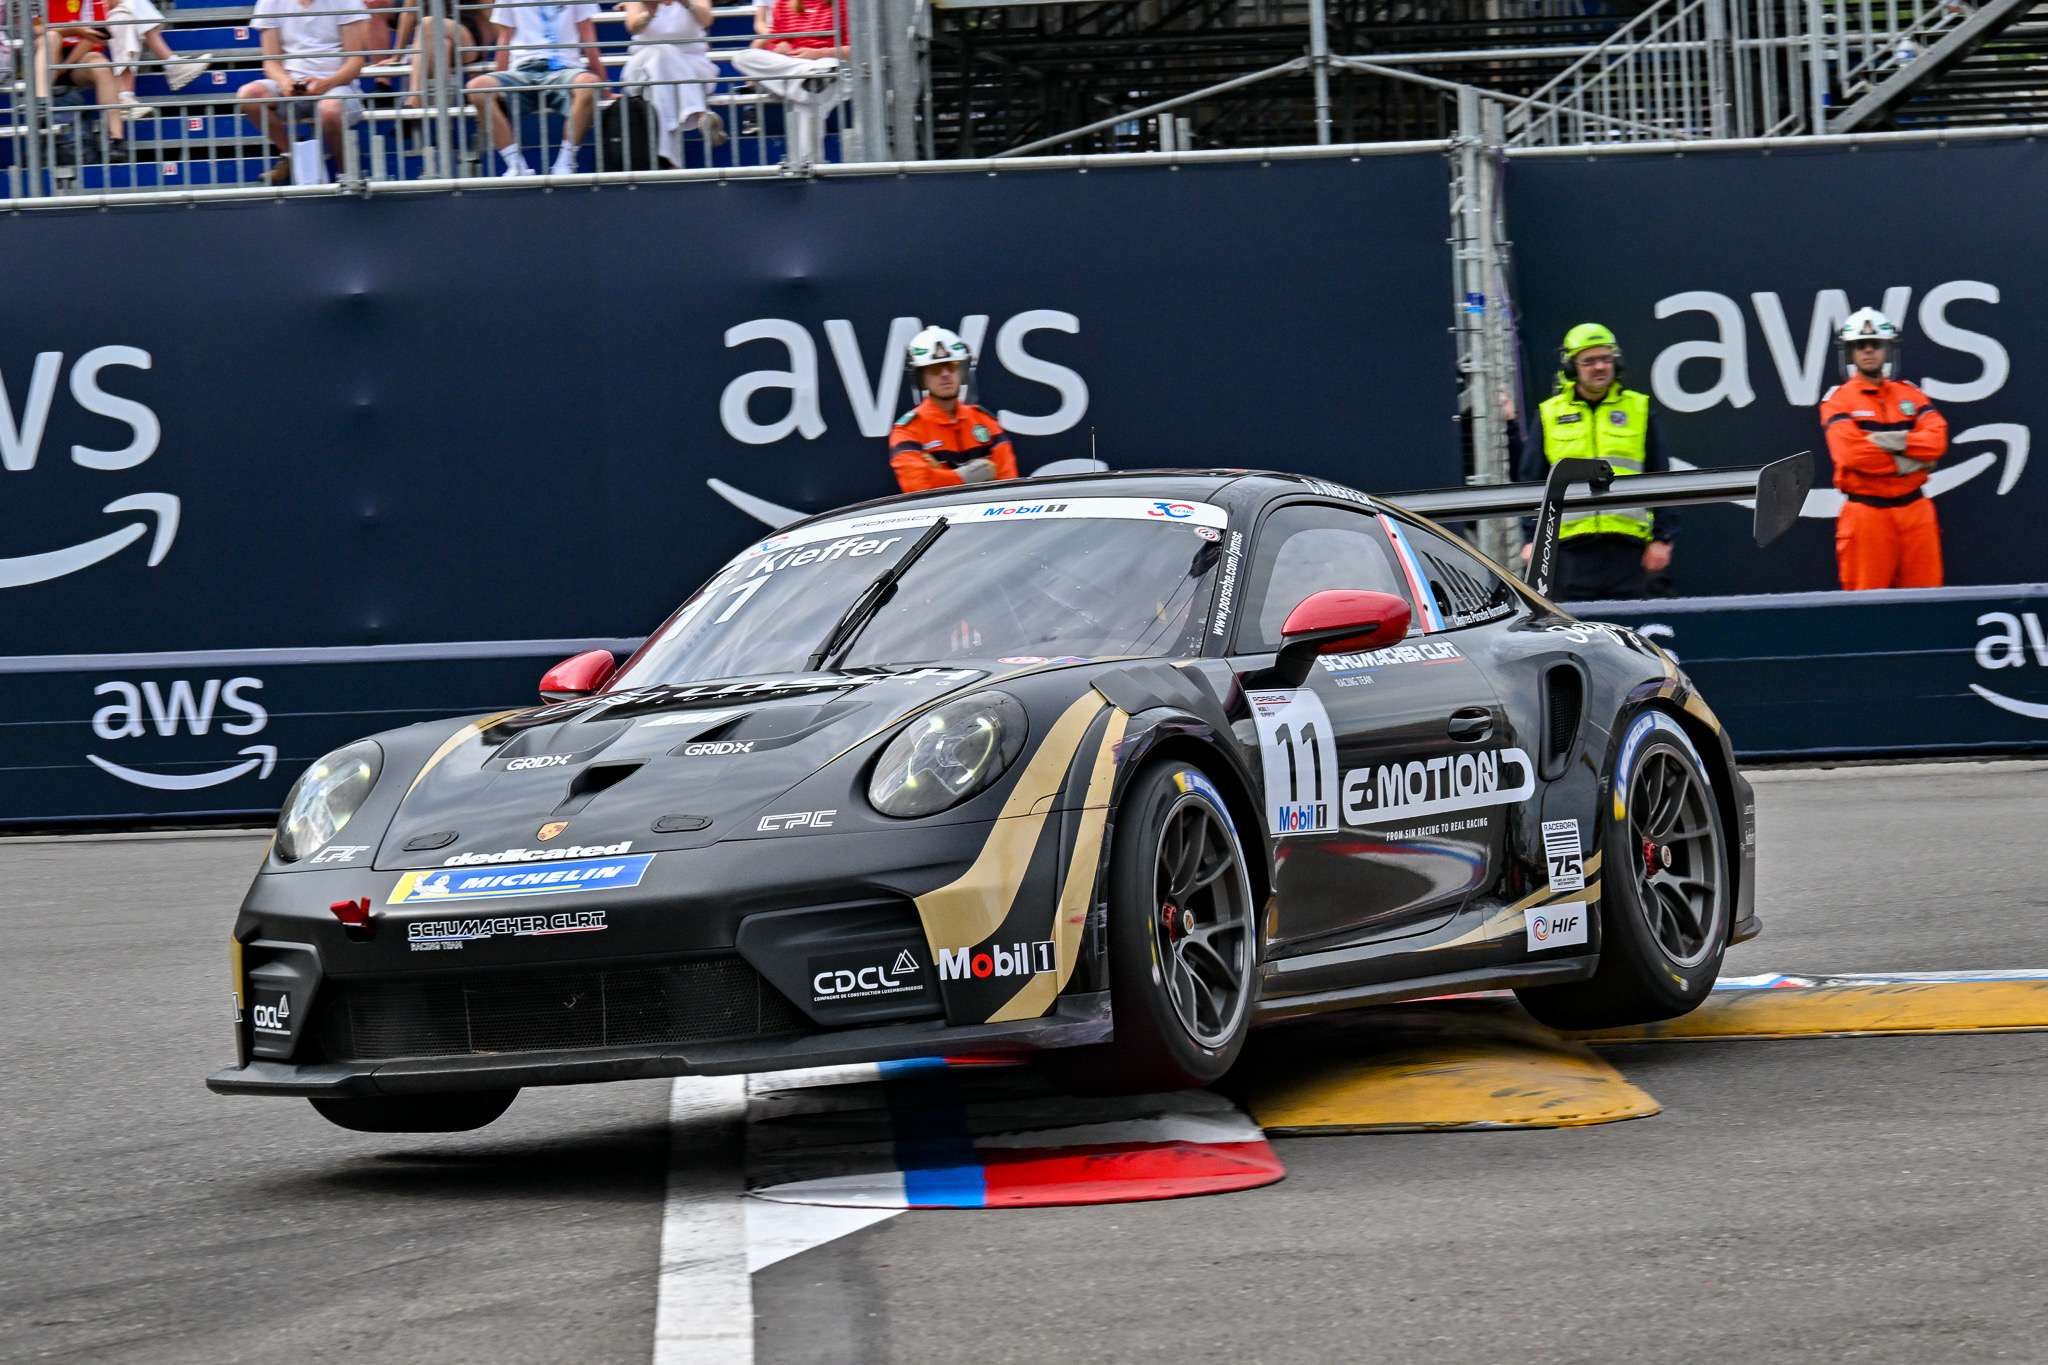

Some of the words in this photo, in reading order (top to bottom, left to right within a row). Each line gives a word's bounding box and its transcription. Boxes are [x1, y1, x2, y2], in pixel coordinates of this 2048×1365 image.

[1651, 281, 2010, 412] aws
[719, 309, 1089, 444] aws
[983, 504, 1045, 517] Mobil
[1540, 501, 1556, 577] BIONEXT
[746, 536, 903, 579] Kieffer
[1212, 530, 1244, 637] www.porsche.com/pmsc
[1469, 608, 1491, 623] Porsche
[1317, 645, 1426, 672] SCHUMACHER
[1334, 677, 1359, 688] RACING
[1357, 675, 1375, 686] TEAM
[92, 677, 269, 740] aws
[1275, 722, 1322, 802] 11
[757, 809, 838, 832] CPC
[1279, 804, 1314, 832] Mobil
[1316, 804, 1327, 828] 1
[1386, 831, 1404, 842] FROM
[1405, 829, 1416, 839] SIM
[1417, 825, 1440, 837] RACING
[1441, 823, 1449, 833] TO
[1450, 821, 1465, 831] REAL
[1466, 817, 1488, 829] RACING
[1543, 821, 1577, 831] RACEBORN
[443, 841, 633, 867] dedicated
[1549, 854, 1582, 876] 75
[458, 865, 626, 890] MICHELIN
[408, 915, 548, 938] SCHUMACHER
[549, 910, 606, 930] CLRT
[1552, 916, 1579, 934] HIF
[410, 941, 440, 951] RACING
[441, 940, 463, 950] TEAM
[938, 942, 1029, 981] Mobil
[813, 966, 900, 994] CDCL
[814, 993, 840, 1002] COMPAGNIE
[847, 990, 881, 998] CONSTRUCTION
[881, 984, 924, 995] LUXEMBOURGEOISE
